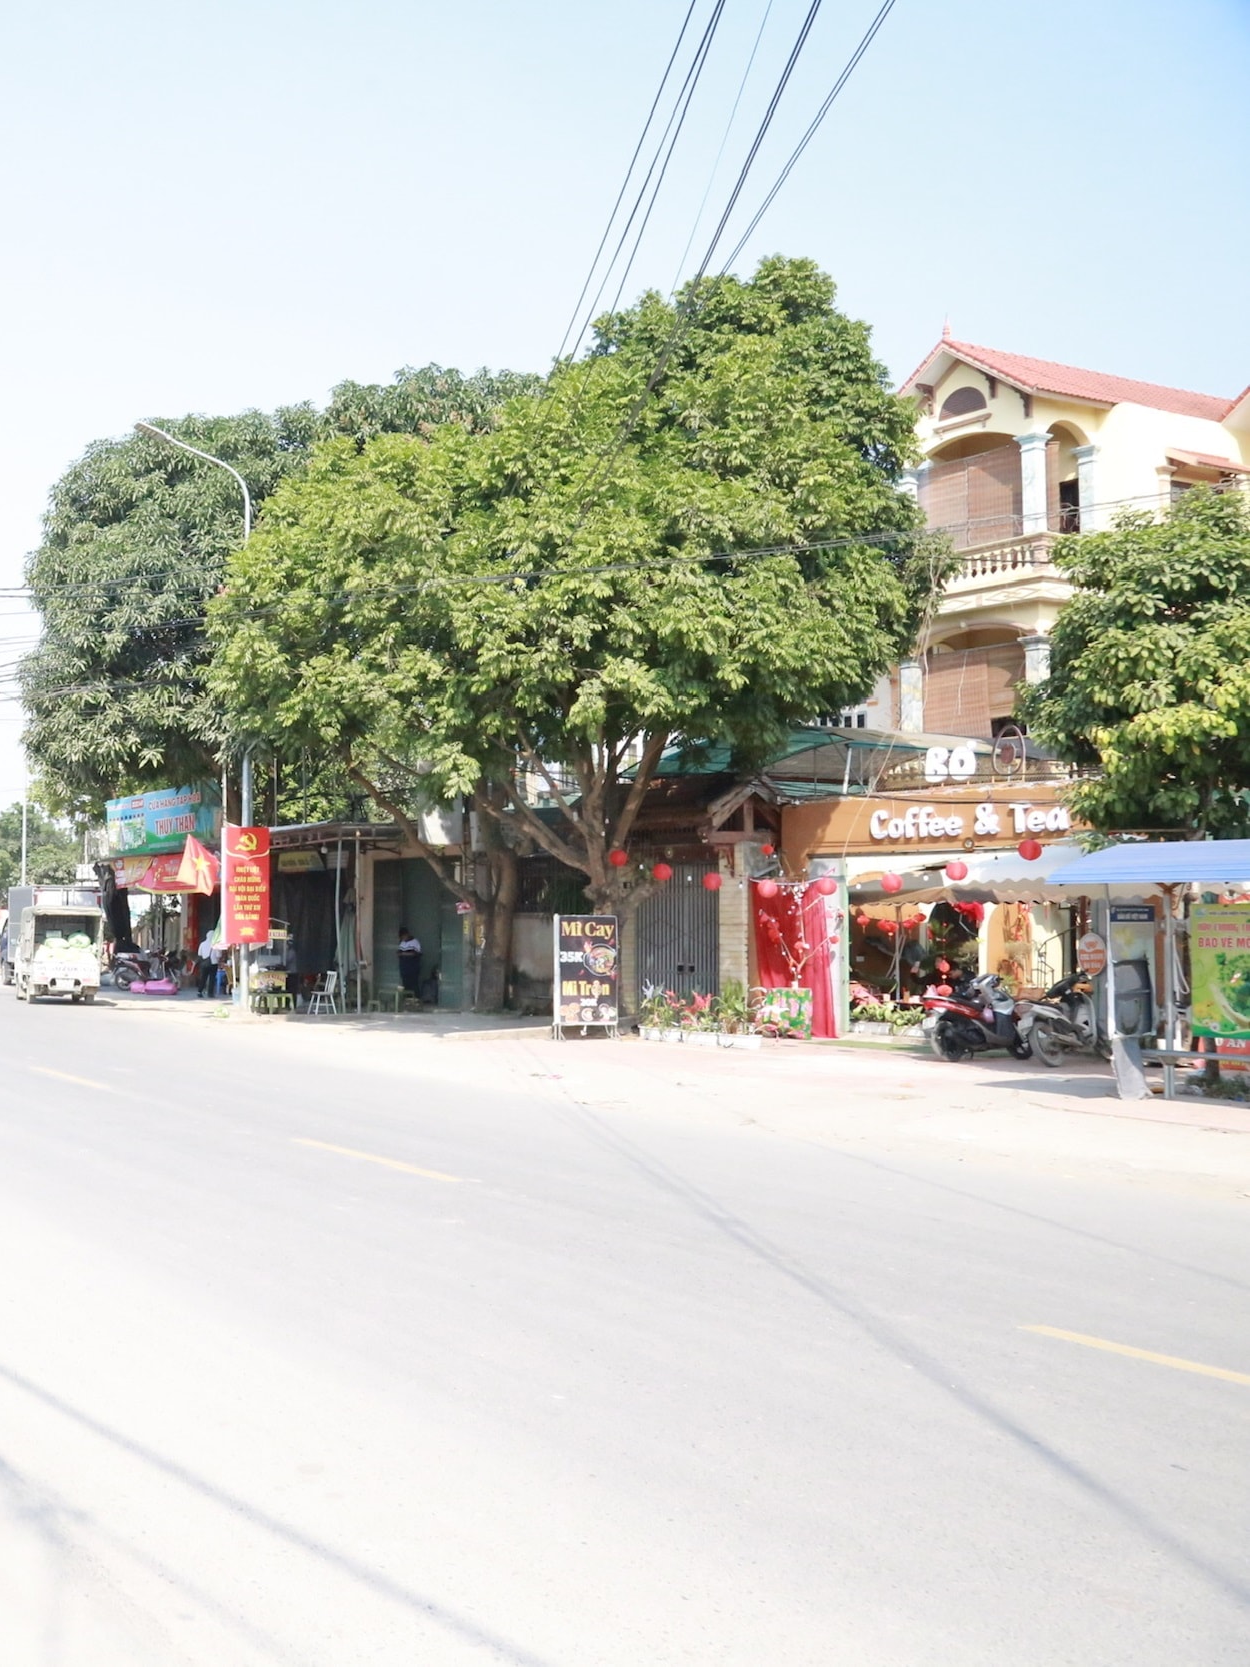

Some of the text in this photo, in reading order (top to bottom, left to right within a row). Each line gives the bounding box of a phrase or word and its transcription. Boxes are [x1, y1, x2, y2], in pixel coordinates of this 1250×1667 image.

[869, 802, 1070, 840] Coffee & Tea
[561, 920, 615, 940] Mì Cay
[559, 951, 584, 963] 35K
